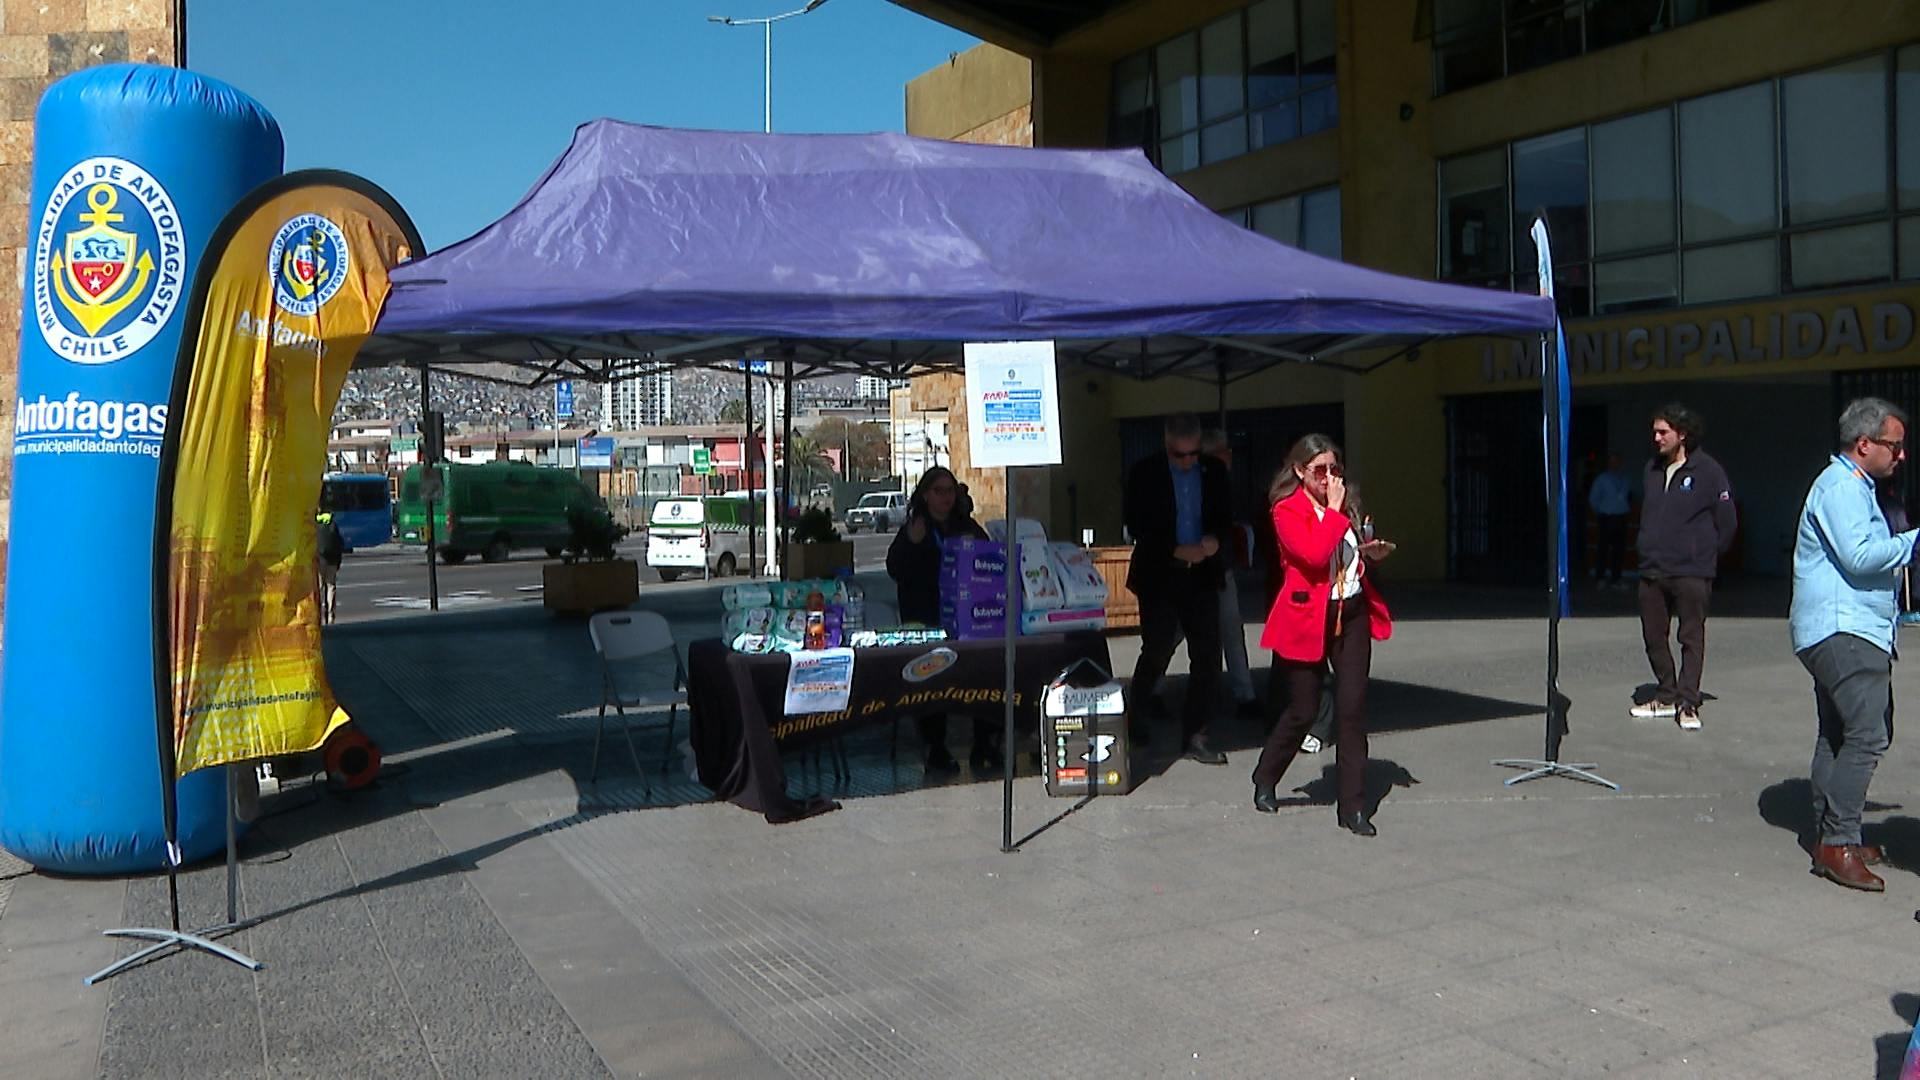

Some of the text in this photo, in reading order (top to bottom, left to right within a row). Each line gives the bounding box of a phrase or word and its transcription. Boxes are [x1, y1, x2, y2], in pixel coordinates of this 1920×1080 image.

[37, 164, 180, 332] MUNICIPALIDAD DE ANTOFAGASTA
[59, 335, 129, 358] CHILE
[861, 699, 887, 717] de
